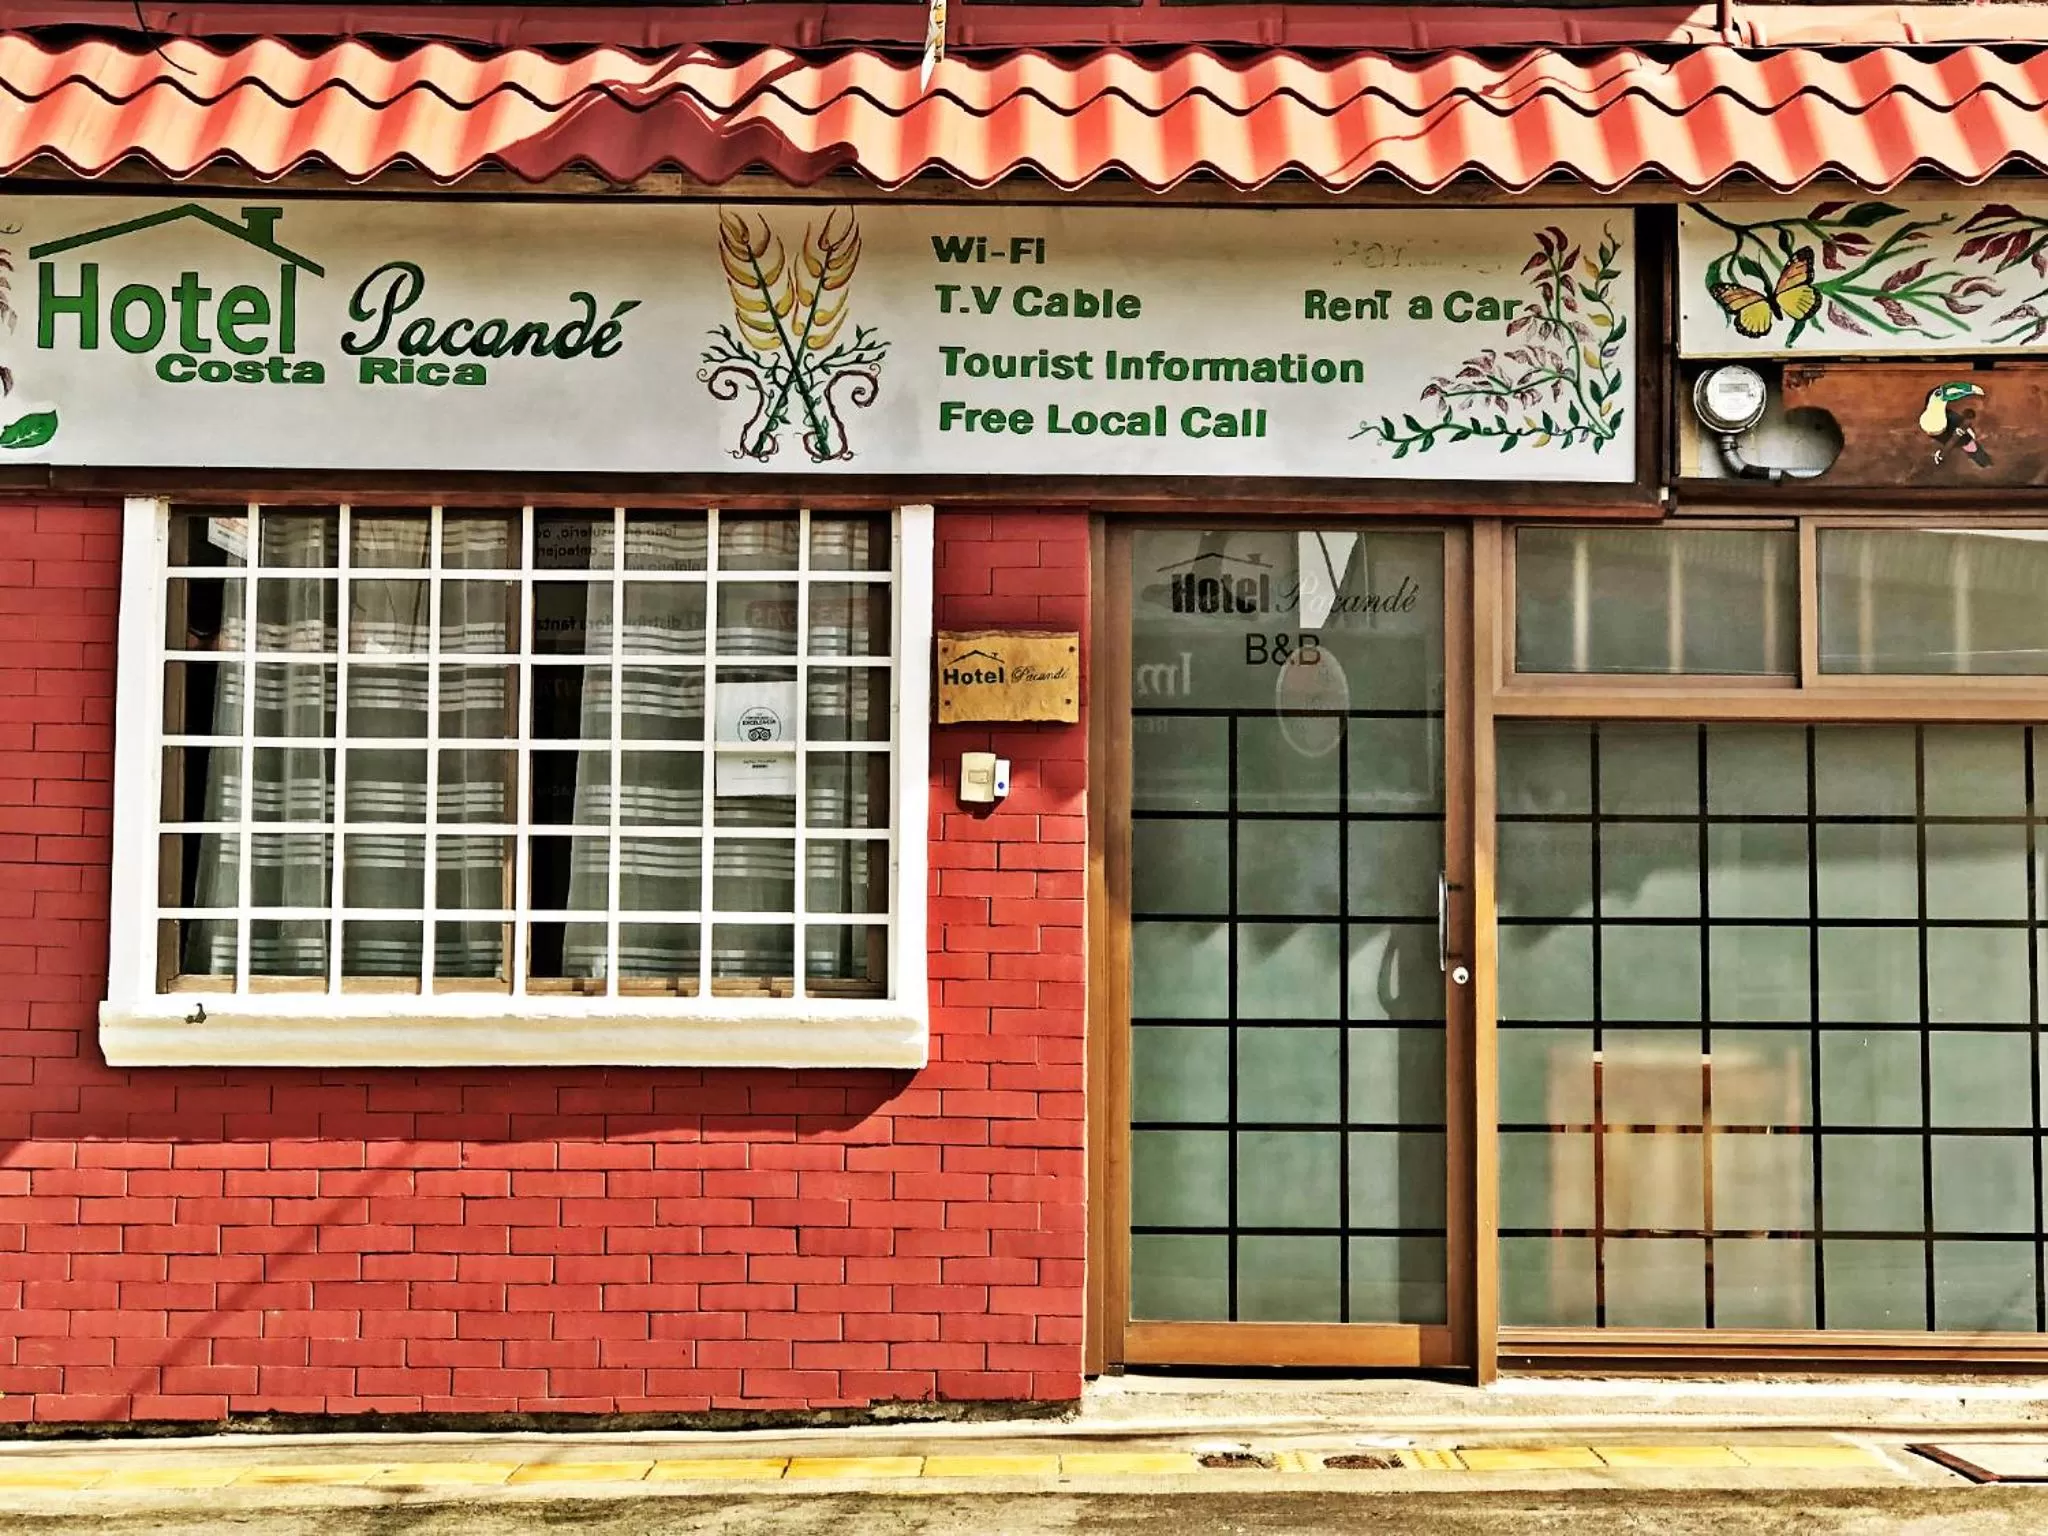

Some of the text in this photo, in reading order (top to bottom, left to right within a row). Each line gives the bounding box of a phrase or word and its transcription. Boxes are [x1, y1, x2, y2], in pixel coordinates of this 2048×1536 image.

[37, 261, 642, 359] Hotel Pacandé
[934, 284, 1141, 319] T.V Cable
[1408, 295, 1433, 320] a
[1443, 290, 1523, 323] Car
[155, 352, 488, 386] Costa Rica
[938, 346, 1364, 384] Tourist Information
[939, 402, 1267, 439] Free Local Call
[1171, 573, 1270, 614] Hotel
[1245, 633, 1321, 667] B&B
[943, 667, 1005, 685] Hotel
